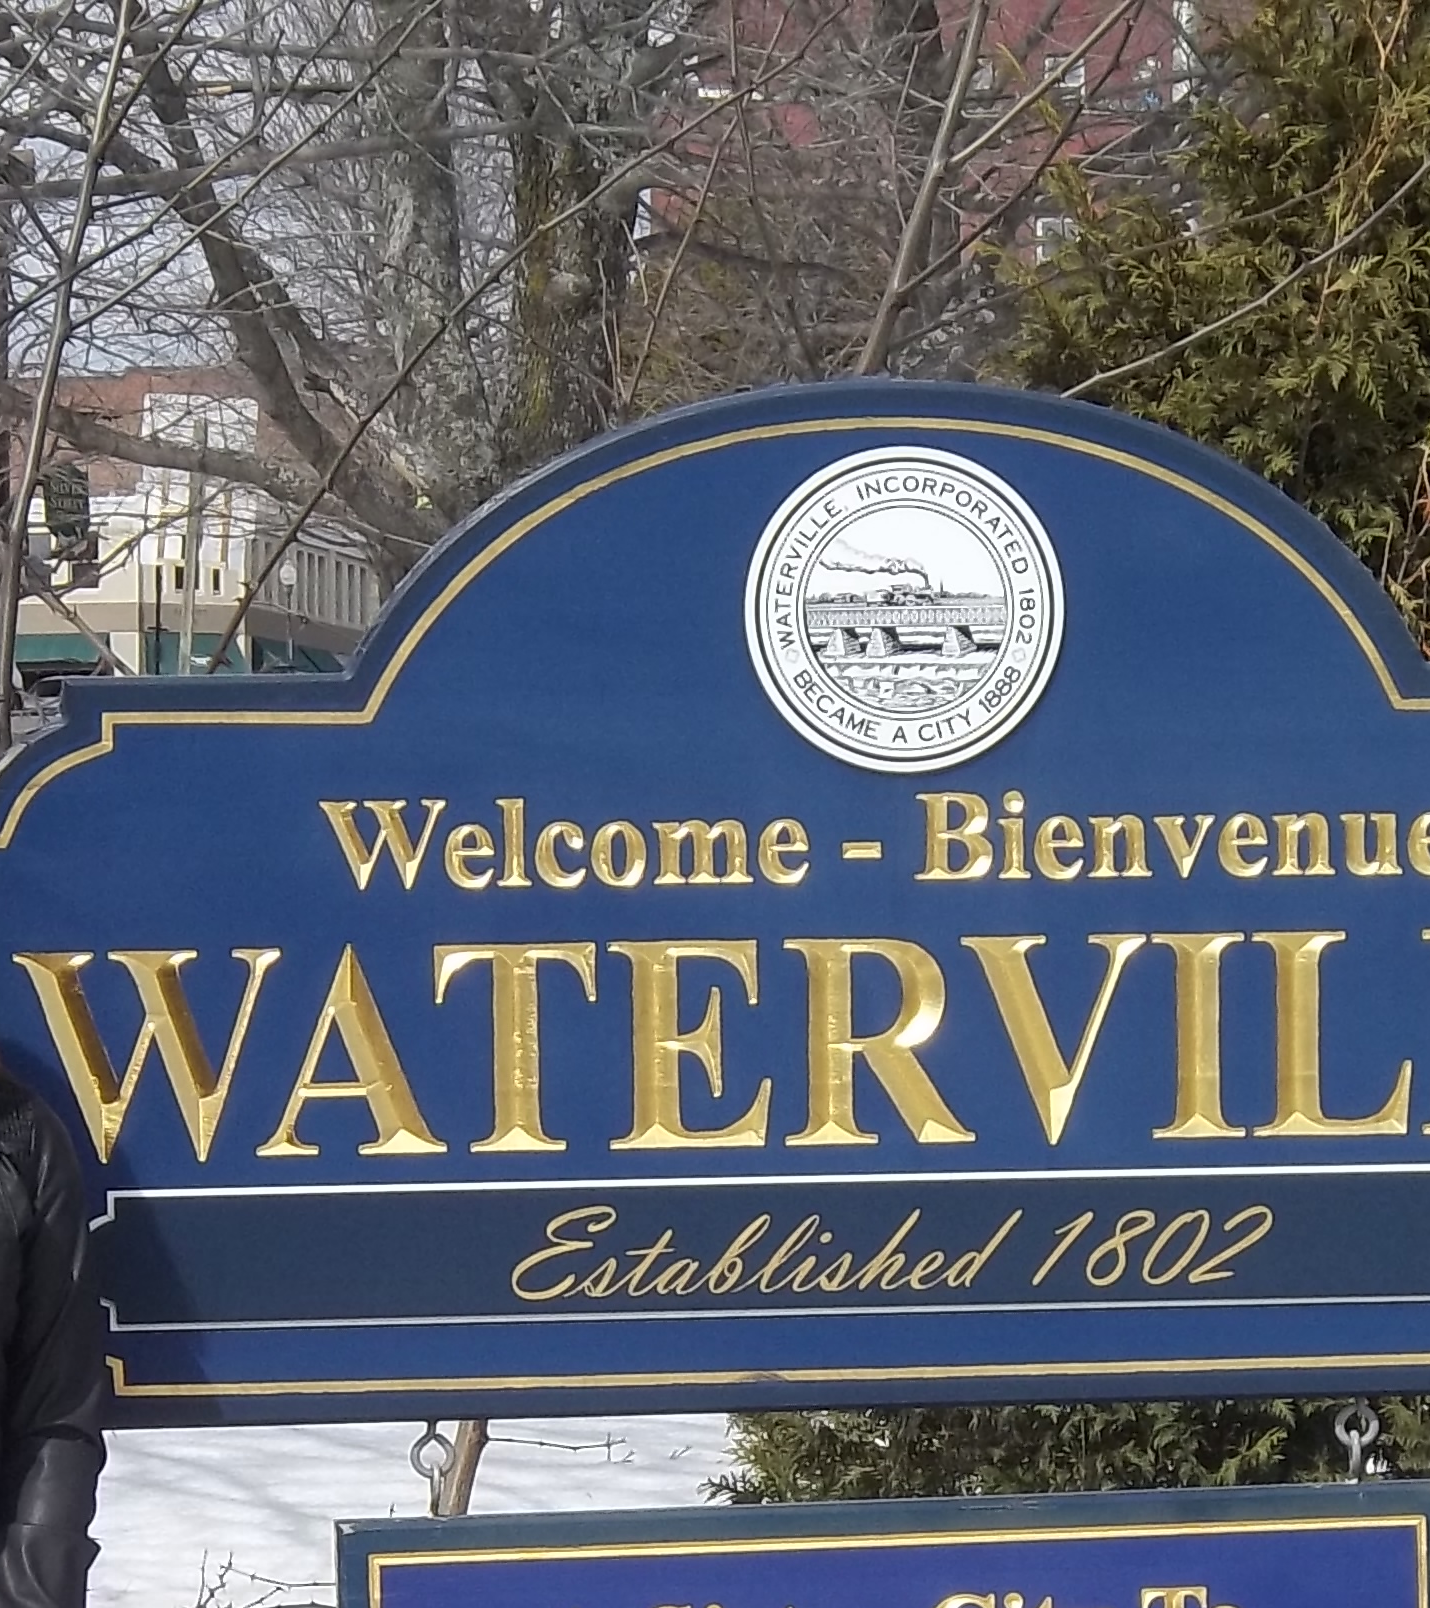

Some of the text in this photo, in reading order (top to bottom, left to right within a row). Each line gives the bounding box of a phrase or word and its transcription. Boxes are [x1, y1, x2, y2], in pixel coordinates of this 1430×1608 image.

[856, 476, 1029, 575] INCORPORATED
[1016, 587, 1036, 646] 1802
[793, 666, 1022, 744] BECAME A CITY 1888
[318, 797, 811, 891] Welcome
[511, 1204, 1273, 1300] Established 1802
